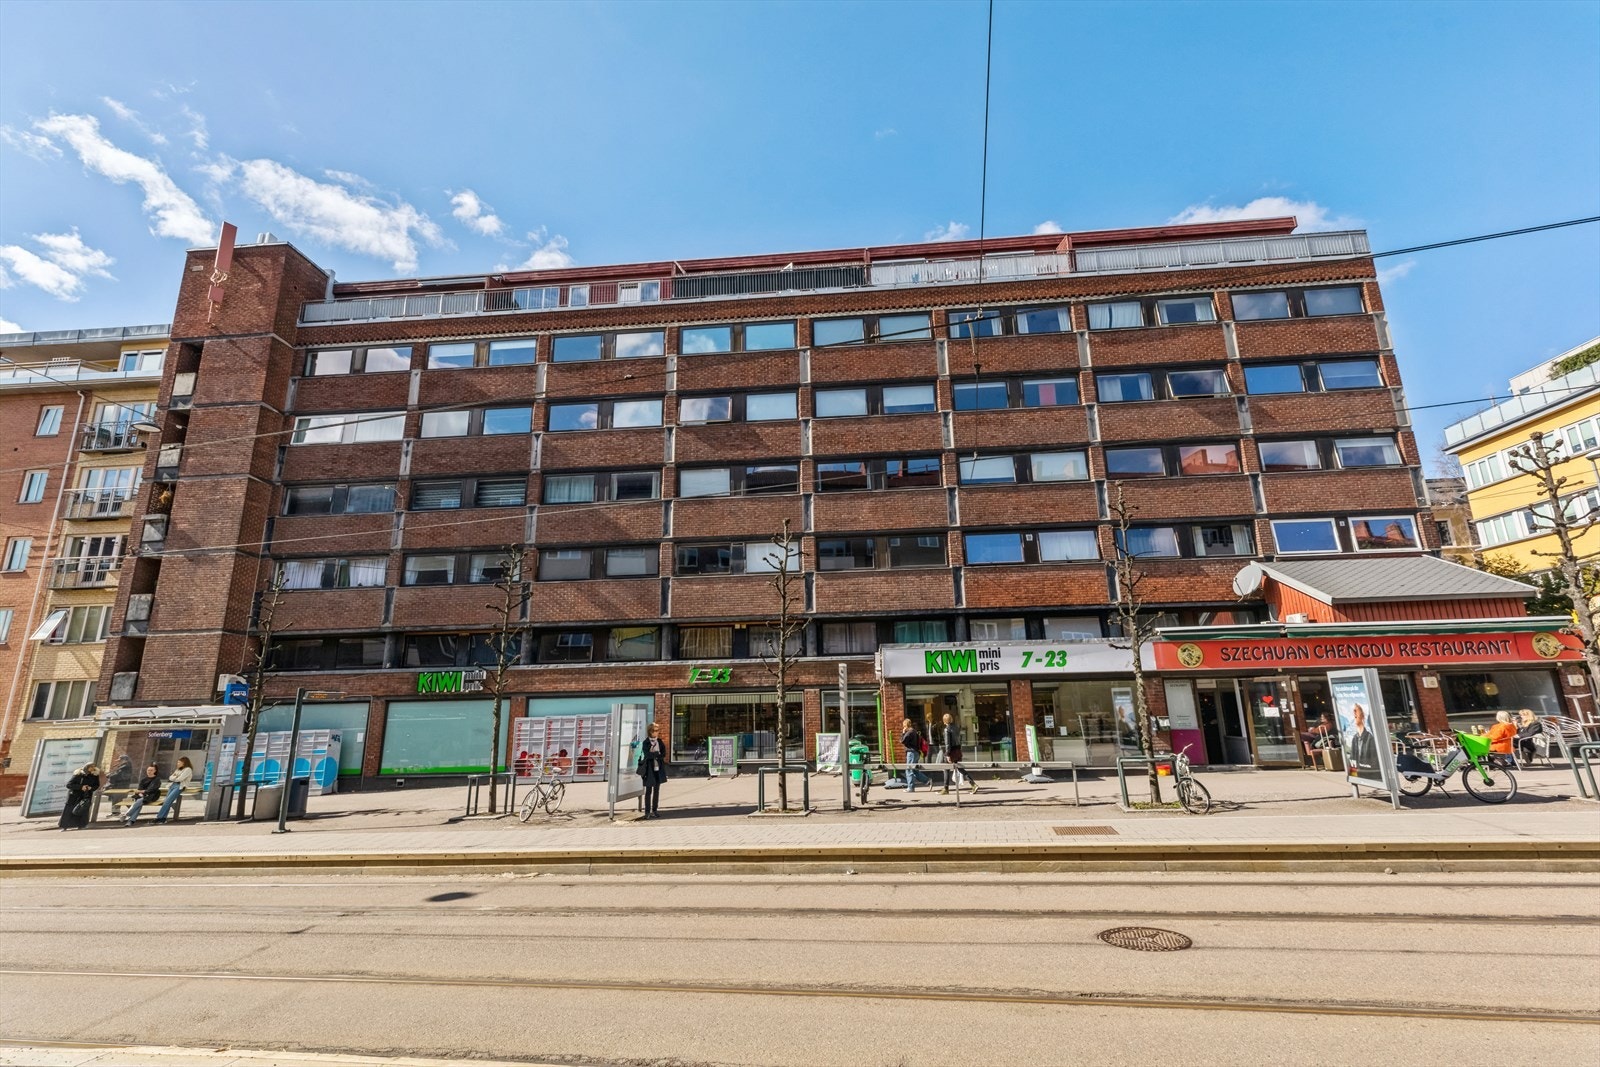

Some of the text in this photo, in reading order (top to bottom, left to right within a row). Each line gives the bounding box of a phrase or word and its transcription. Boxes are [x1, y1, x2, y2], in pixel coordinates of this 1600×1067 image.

[925, 649, 978, 673] KIWI
[979, 647, 1001, 659] mini
[1220, 639, 1513, 661] SZECHUAN CHENGDU RESTAURANT
[979, 660, 1000, 673] pris
[417, 671, 462, 693] KIWI
[148, 731, 173, 739] Sofienberg
